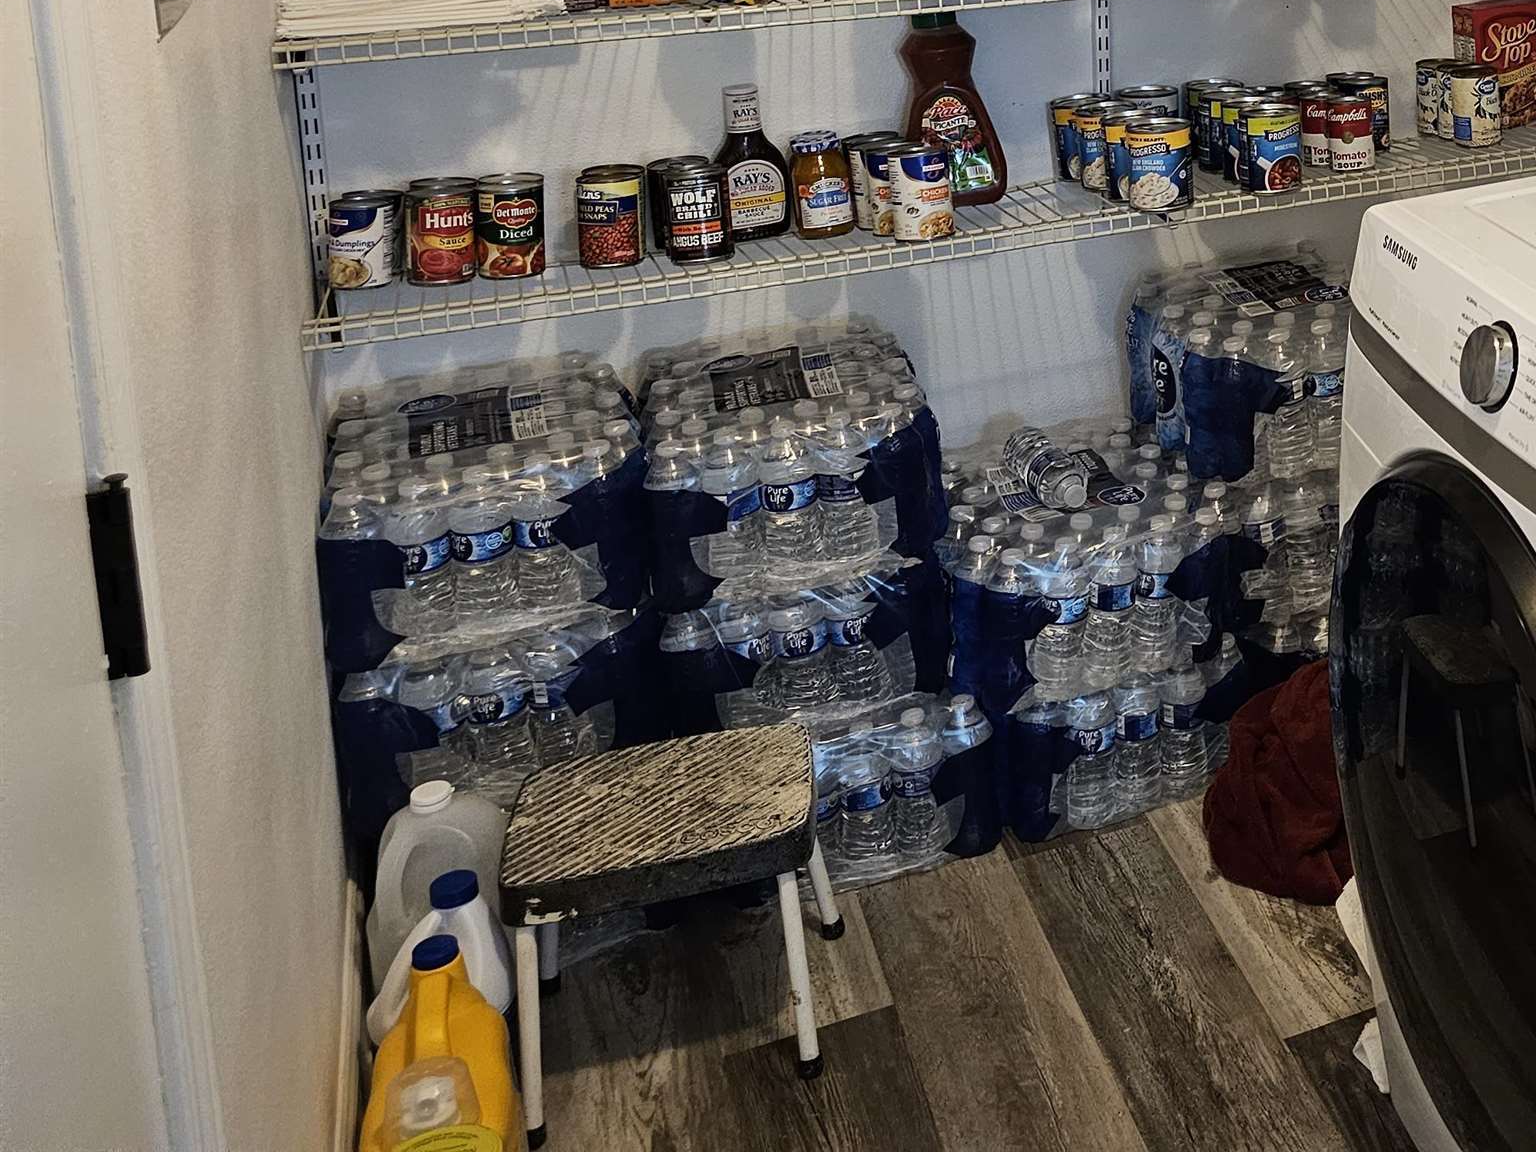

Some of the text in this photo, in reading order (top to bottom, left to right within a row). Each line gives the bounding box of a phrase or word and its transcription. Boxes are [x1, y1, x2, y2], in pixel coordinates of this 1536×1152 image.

[1503, 40, 1531, 69] Top
[933, 117, 967, 129] PICANTE
[1130, 144, 1167, 157] PROGRESSO
[1333, 151, 1367, 161] Tomato
[1337, 161, 1362, 169] SOUP
[732, 172, 771, 187] RAY'S
[670, 189, 717, 206] WOLF
[734, 196, 774, 207] ORIGINAL
[496, 206, 537, 217] Del Monte
[595, 205, 615, 213] PEAS
[673, 204, 713, 213] BRAND
[676, 210, 712, 219] CHILI
[425, 210, 474, 229] Hunt's
[500, 226, 533, 239] Diced
[335, 240, 375, 250] Dumplings
[438, 236, 467, 247] Sauce
[672, 232, 724, 247] ANGUS BEEF
[1383, 234, 1418, 270] SAMSUNG
[767, 485, 789, 497] Pure
[769, 493, 788, 505] Life
[785, 630, 810, 643] Pure
[789, 637, 808, 649] Life
[473, 694, 498, 707] Pure
[477, 701, 497, 714] Life
[1078, 729, 1100, 744] Pure
